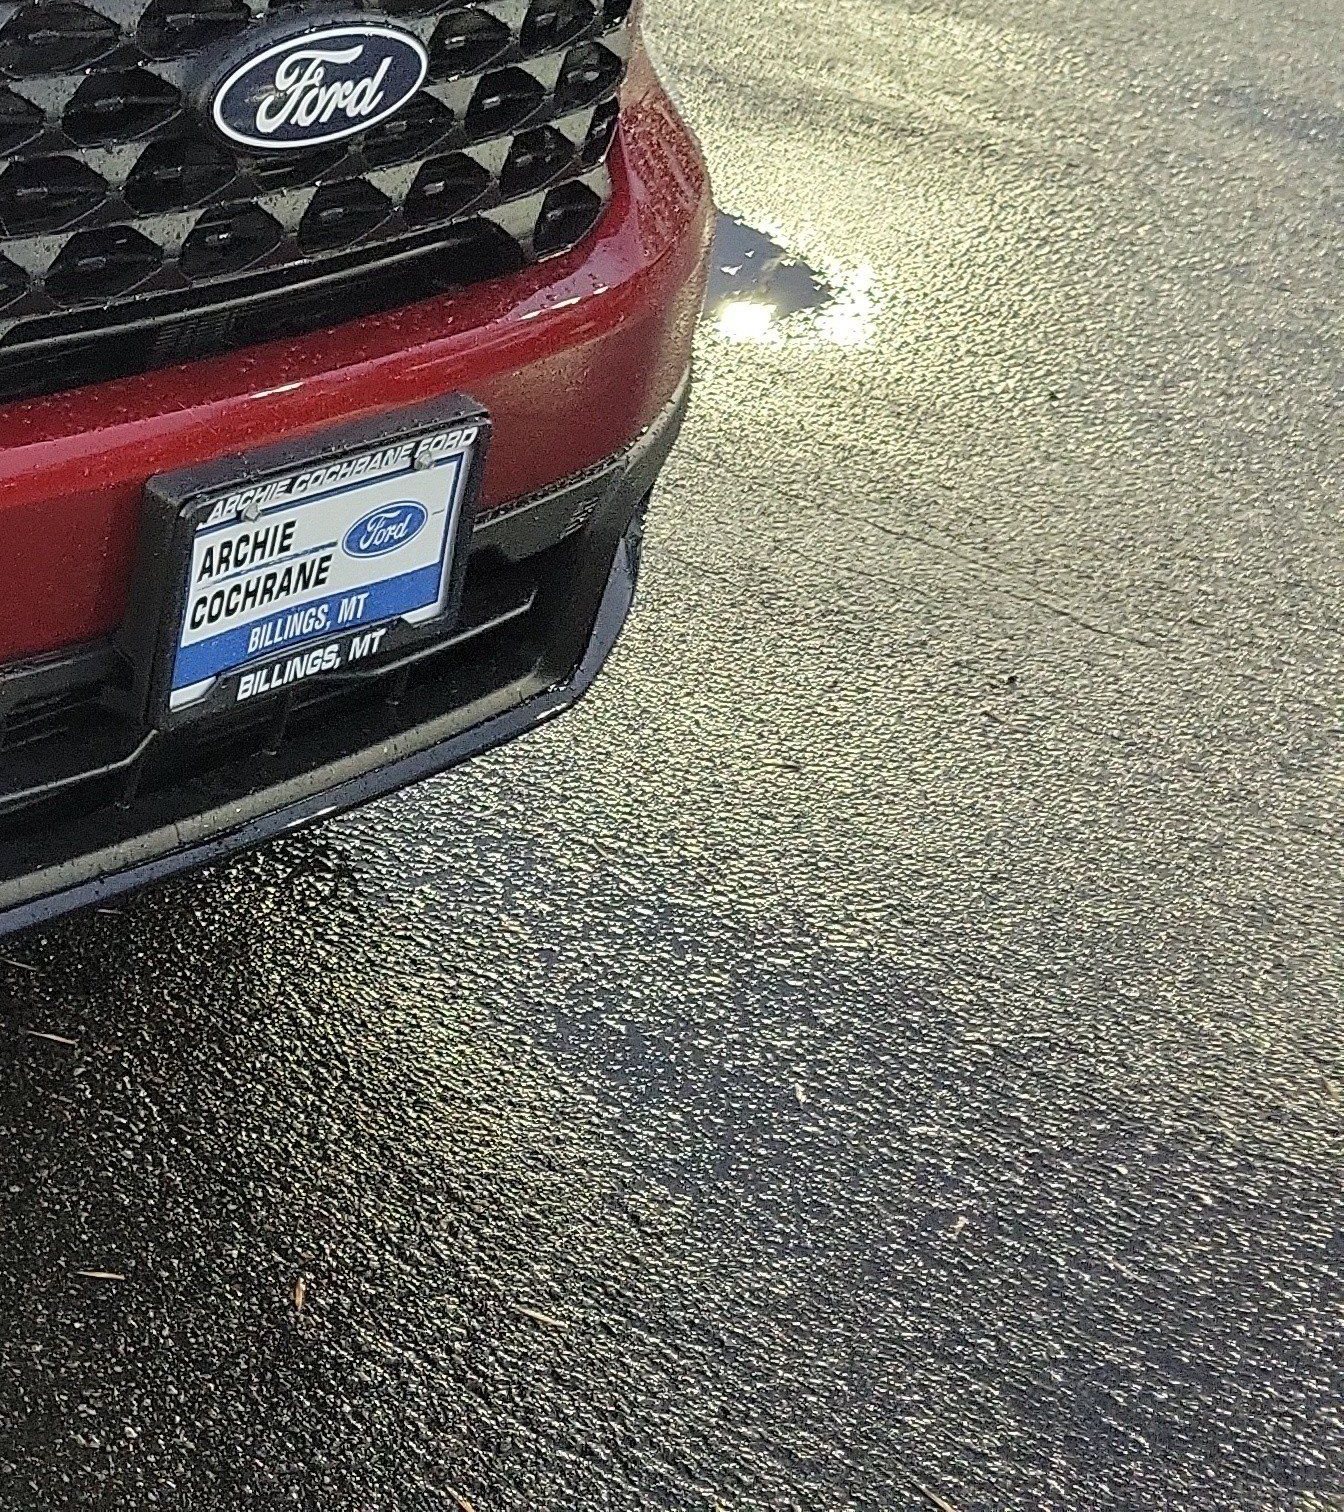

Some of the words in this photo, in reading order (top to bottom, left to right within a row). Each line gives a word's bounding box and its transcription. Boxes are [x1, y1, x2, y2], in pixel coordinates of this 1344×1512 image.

[255, 44, 393, 133] Ford
[207, 478, 293, 523] ARCHIE
[291, 441, 416, 494] COCHRANE
[414, 426, 479, 458] FORD
[197, 519, 297, 583] ARCHIE
[359, 510, 413, 550] Ford
[189, 553, 333, 630] COCHRANE
[247, 603, 331, 654] BILLINGS,
[337, 592, 370, 624] MT
[236, 644, 342, 701] BILLINGS,
[348, 628, 388, 662] MT
